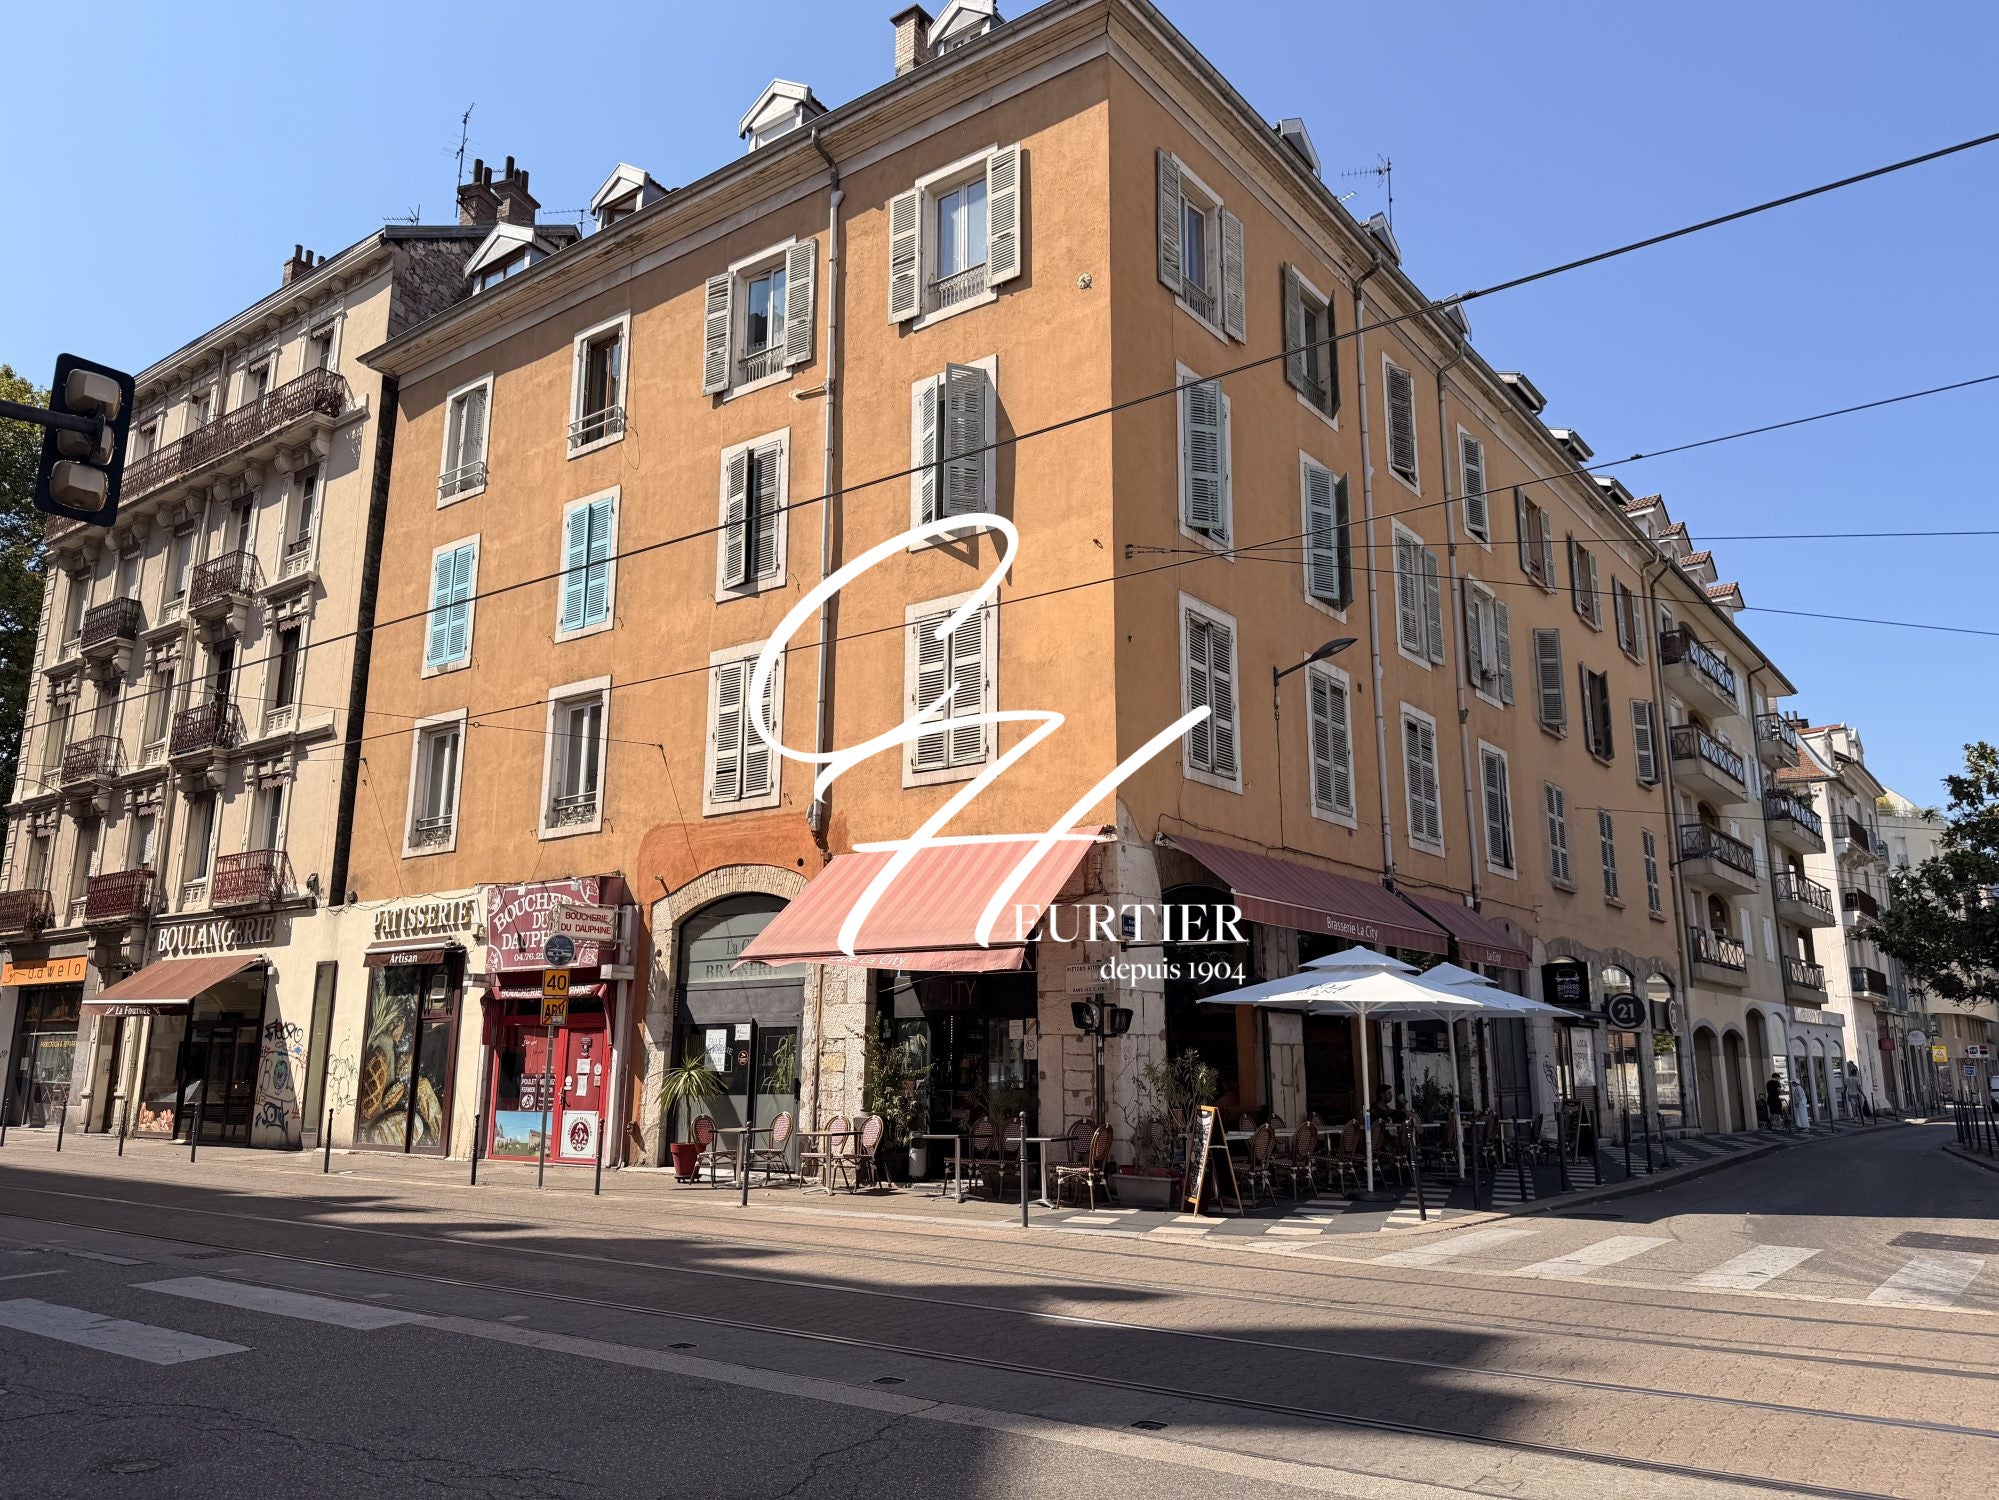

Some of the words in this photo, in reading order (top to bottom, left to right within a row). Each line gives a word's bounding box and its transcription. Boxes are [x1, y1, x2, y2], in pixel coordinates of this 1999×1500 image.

[373, 901, 470, 932] PATISSERIE
[565, 911, 609, 922] BOUCHERIE
[157, 916, 274, 951] BOULANGERIE
[560, 923, 572, 932] DU
[575, 924, 612, 935] DAUPHINE
[1326, 916, 1356, 935] Brasserie
[1356, 923, 1365, 936] La
[1365, 925, 1378, 941] City
[726, 940, 738, 955] La
[389, 951, 418, 964] Artisan
[859, 955, 876, 964] La
[880, 953, 908, 967] City
[547, 975, 567, 991] 40
[115, 1006, 123, 1015] La
